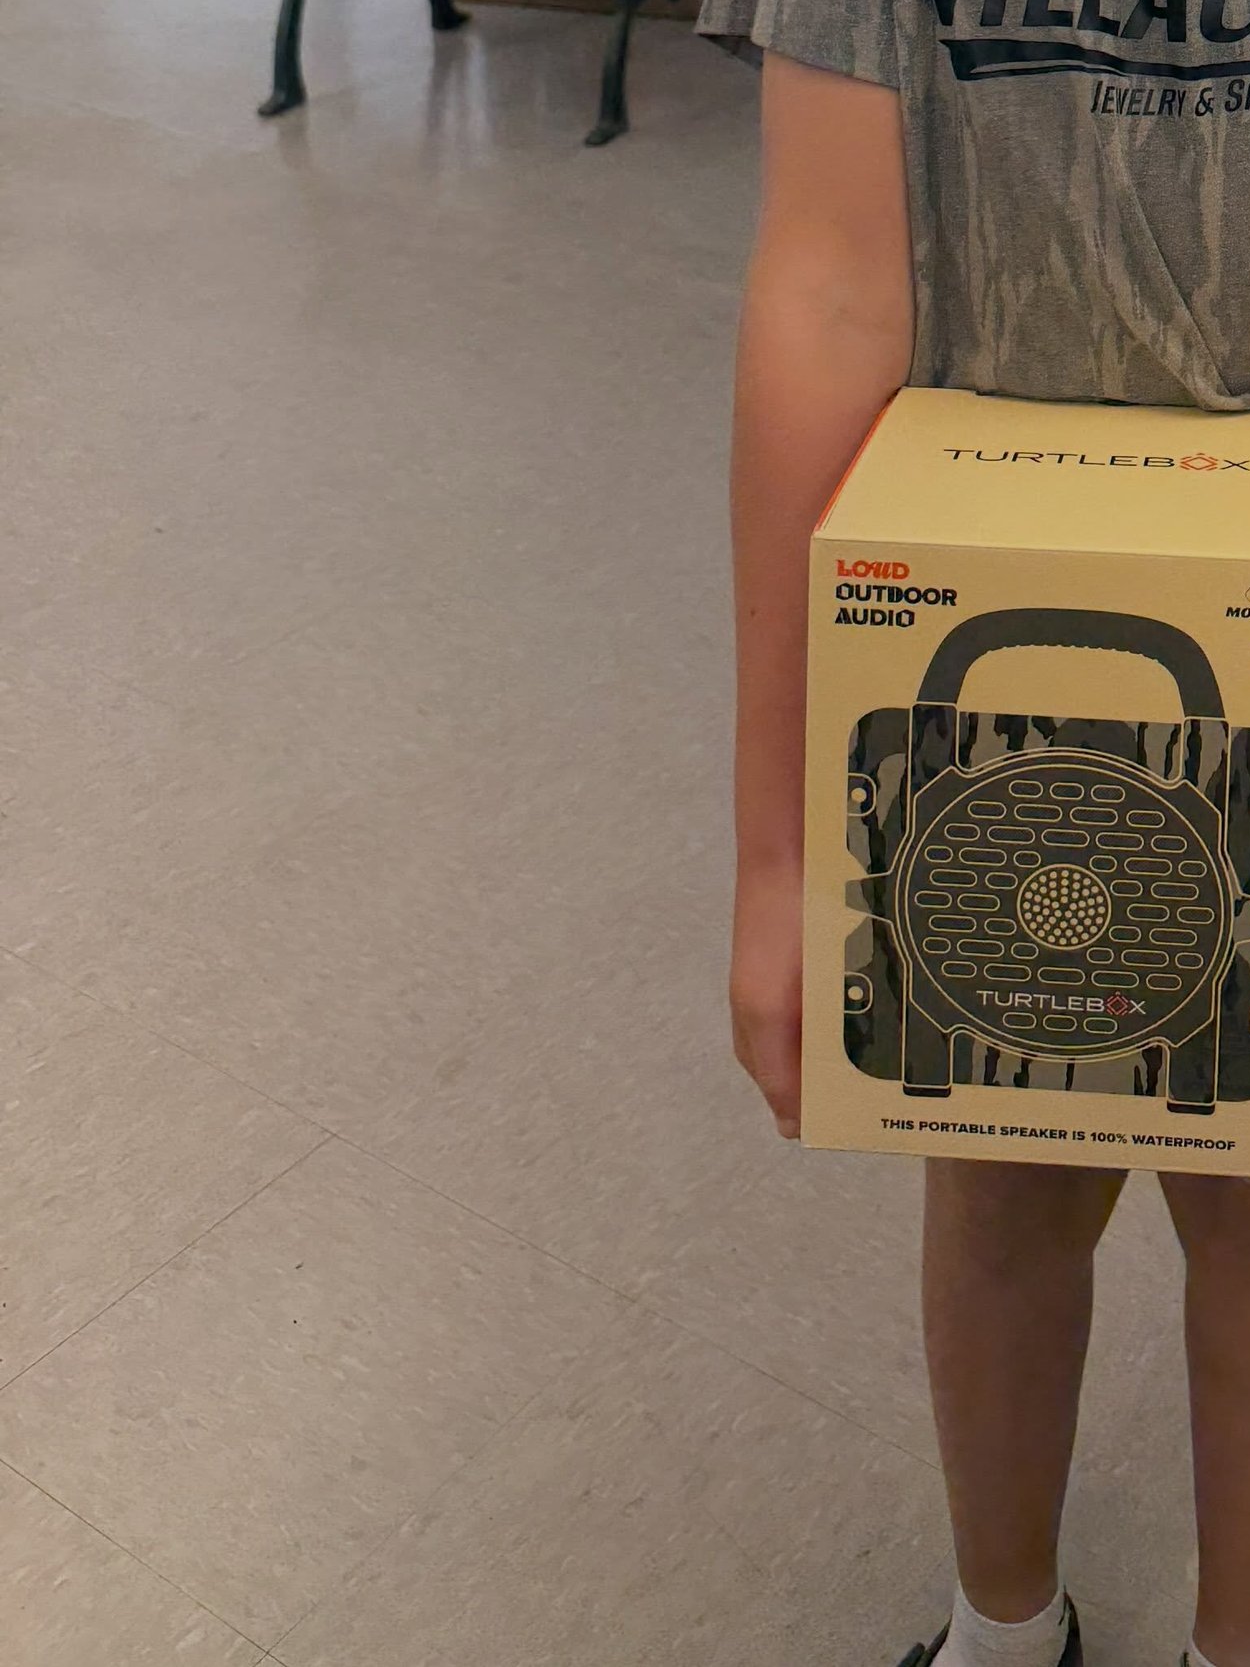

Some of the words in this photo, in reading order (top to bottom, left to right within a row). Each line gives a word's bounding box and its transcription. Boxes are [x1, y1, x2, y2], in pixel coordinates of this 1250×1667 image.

[1194, 87, 1214, 117] &
[836, 559, 910, 580] LOUD
[835, 582, 958, 606] OUTDOOR
[834, 607, 916, 628] AUDIO
[975, 989, 1147, 1016] TURTLEBOX
[880, 1118, 915, 1131] THIS
[918, 1120, 996, 1135] PORTABLE
[999, 1125, 1068, 1140] SPEAKER
[1072, 1130, 1086, 1141] IS
[1090, 1131, 1128, 1145] 100%
[1131, 1134, 1236, 1151] WATERPROOF
